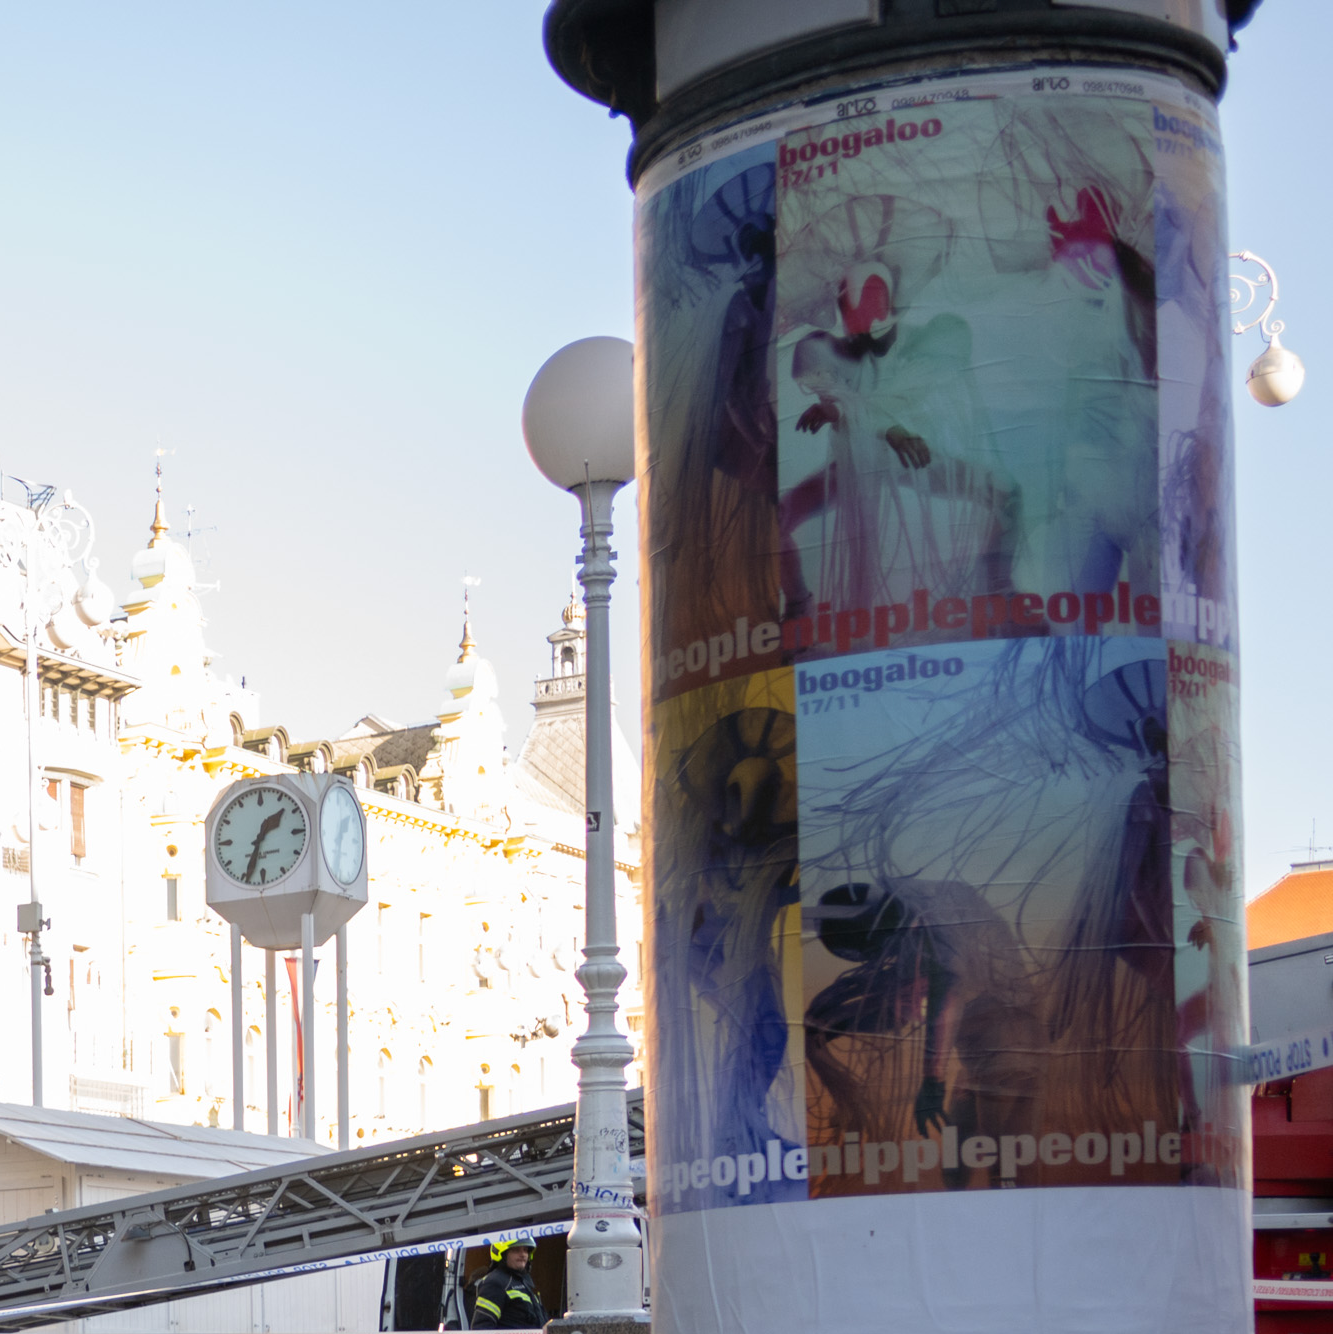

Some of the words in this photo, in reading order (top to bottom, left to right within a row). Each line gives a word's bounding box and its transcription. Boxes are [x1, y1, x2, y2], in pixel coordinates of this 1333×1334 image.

[1032, 76, 1070, 92] arto
[1083, 81, 1145, 96] 098/470948
[836, 96, 878, 118] arto
[778, 117, 943, 170] boogaloo
[781, 160, 839, 189] 17/11
[799, 654, 965, 696] boogaloo
[800, 693, 861, 716] 17/11
